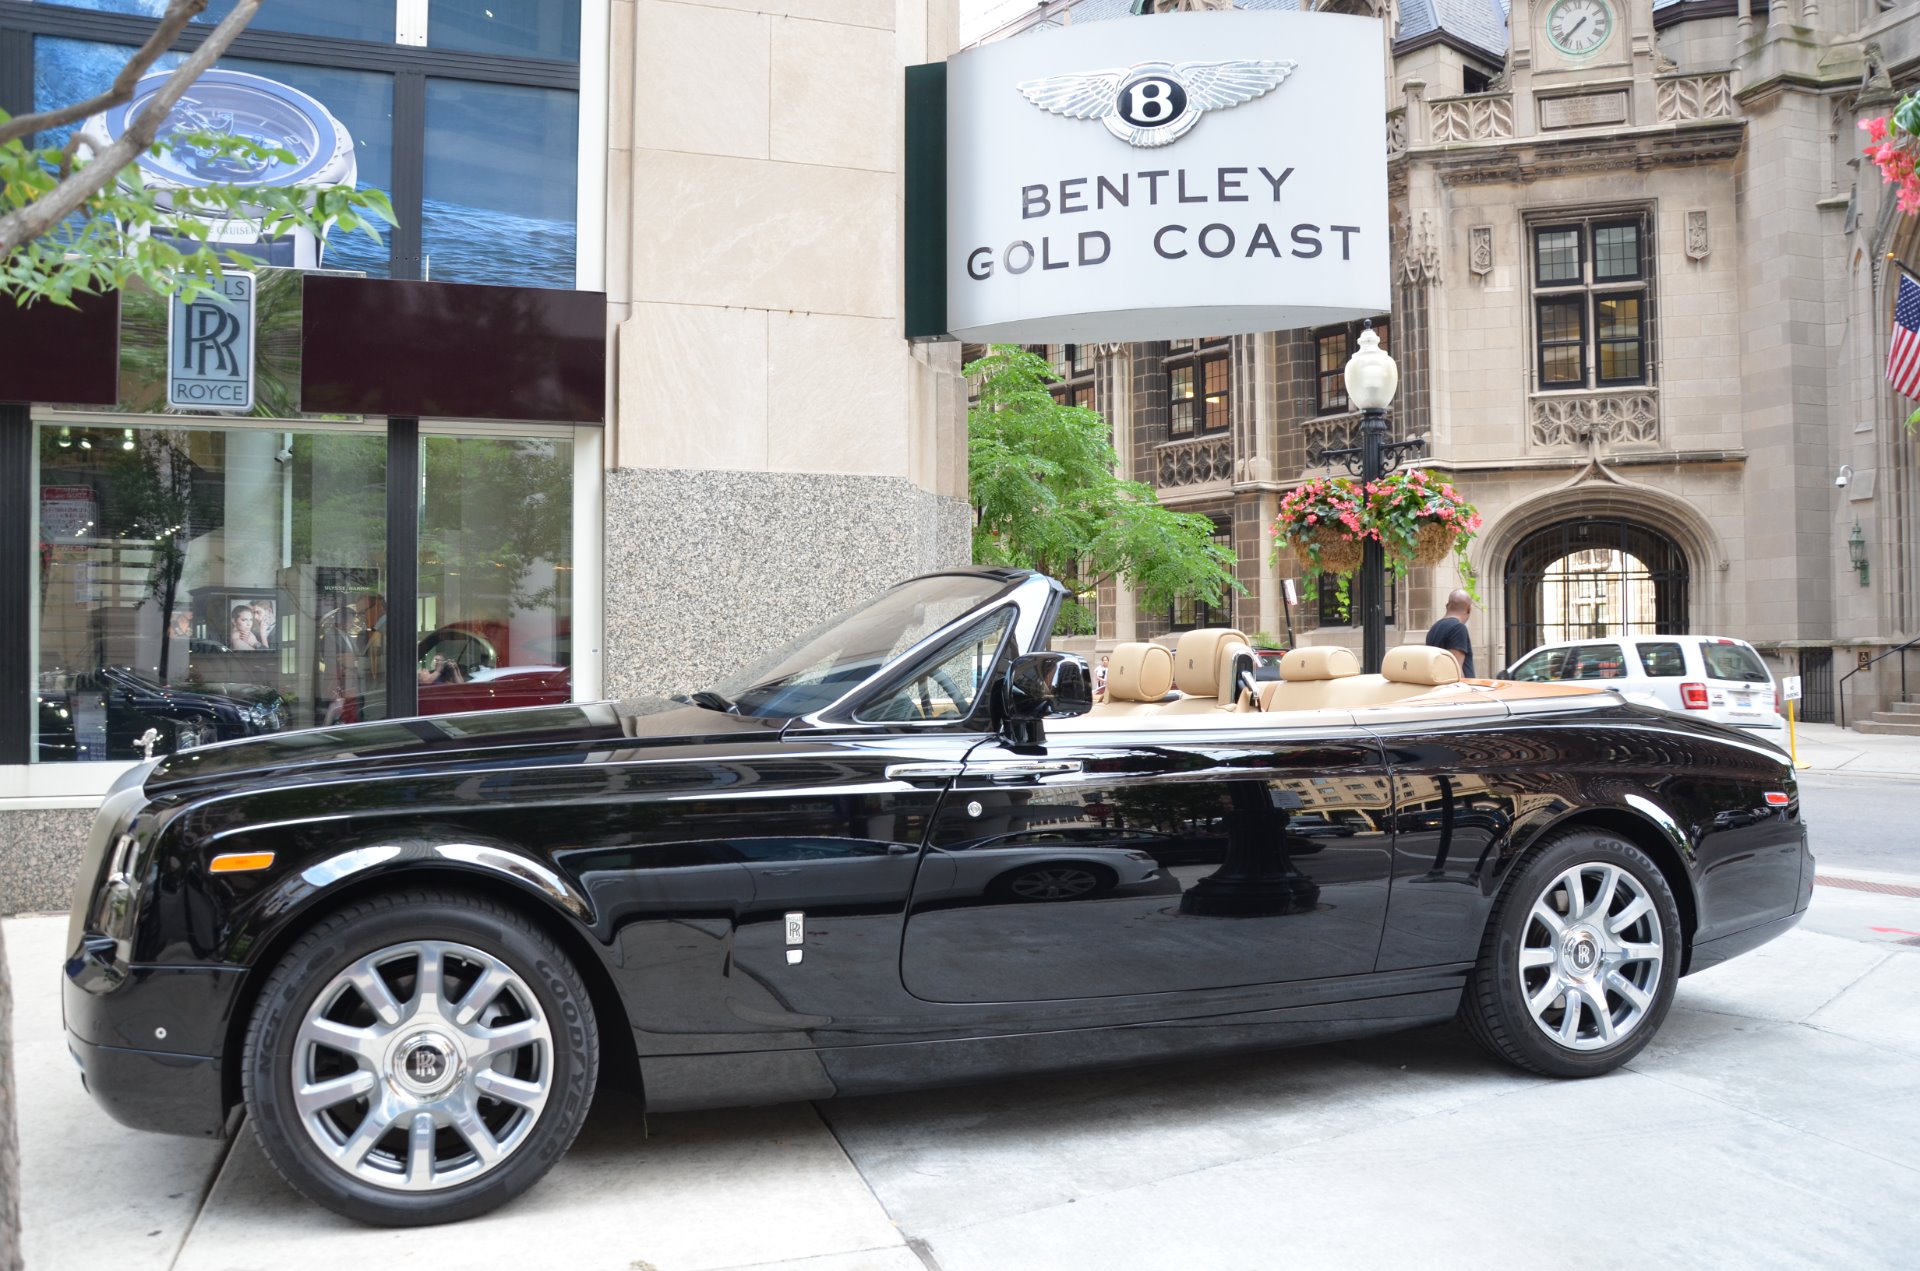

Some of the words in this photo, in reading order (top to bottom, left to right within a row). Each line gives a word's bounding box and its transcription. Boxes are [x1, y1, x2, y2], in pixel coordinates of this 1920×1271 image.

[1130, 80, 1174, 123] B
[1021, 166, 1295, 220] BENTLEY
[967, 230, 1112, 281] GOLD
[1153, 222, 1361, 261] COAST
[177, 383, 243, 401] ROYCE
